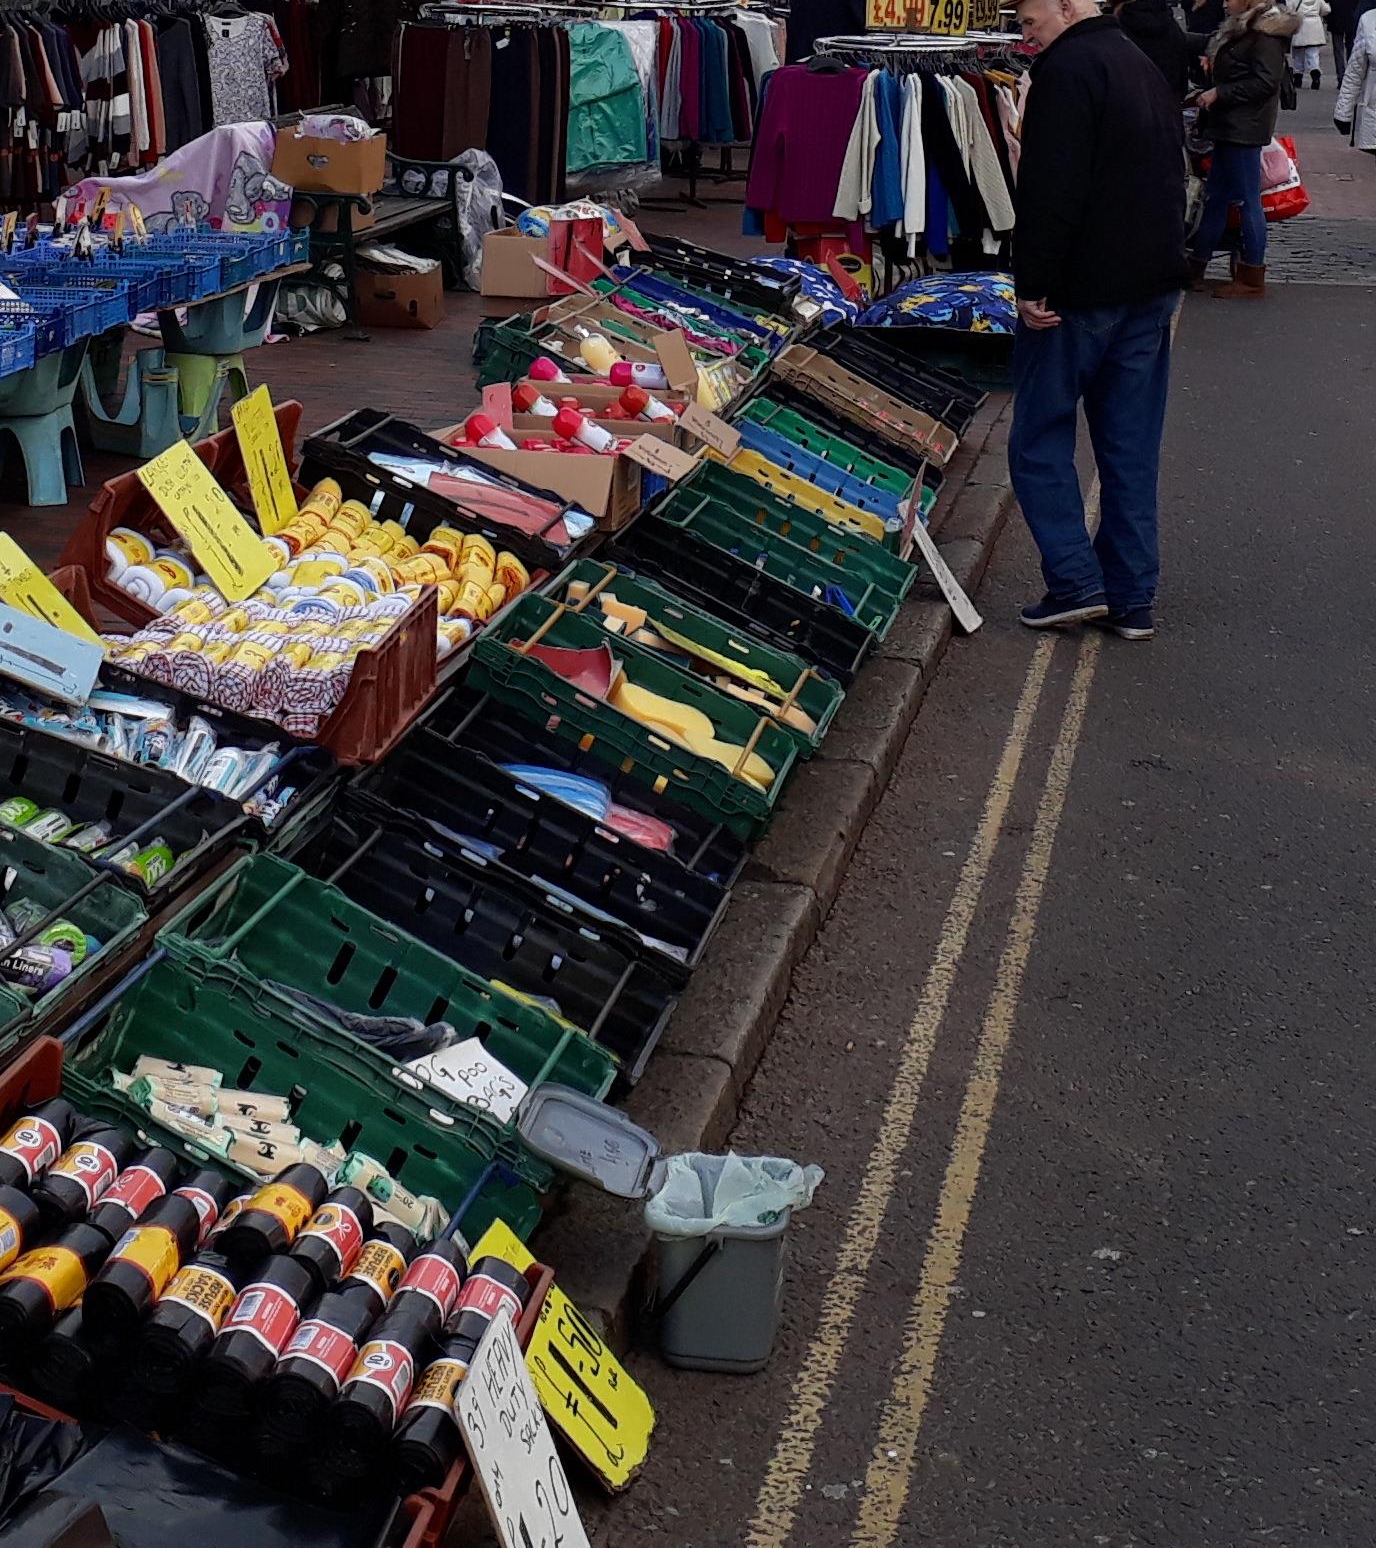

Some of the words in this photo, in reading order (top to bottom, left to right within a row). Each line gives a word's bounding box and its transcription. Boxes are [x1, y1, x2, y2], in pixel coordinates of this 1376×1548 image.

[77, 1155, 94, 1167] 10
[367, 1355, 386, 1370] 10
[482, 1320, 518, 1410] HEAVY
[499, 1378, 530, 1439] DUTY
